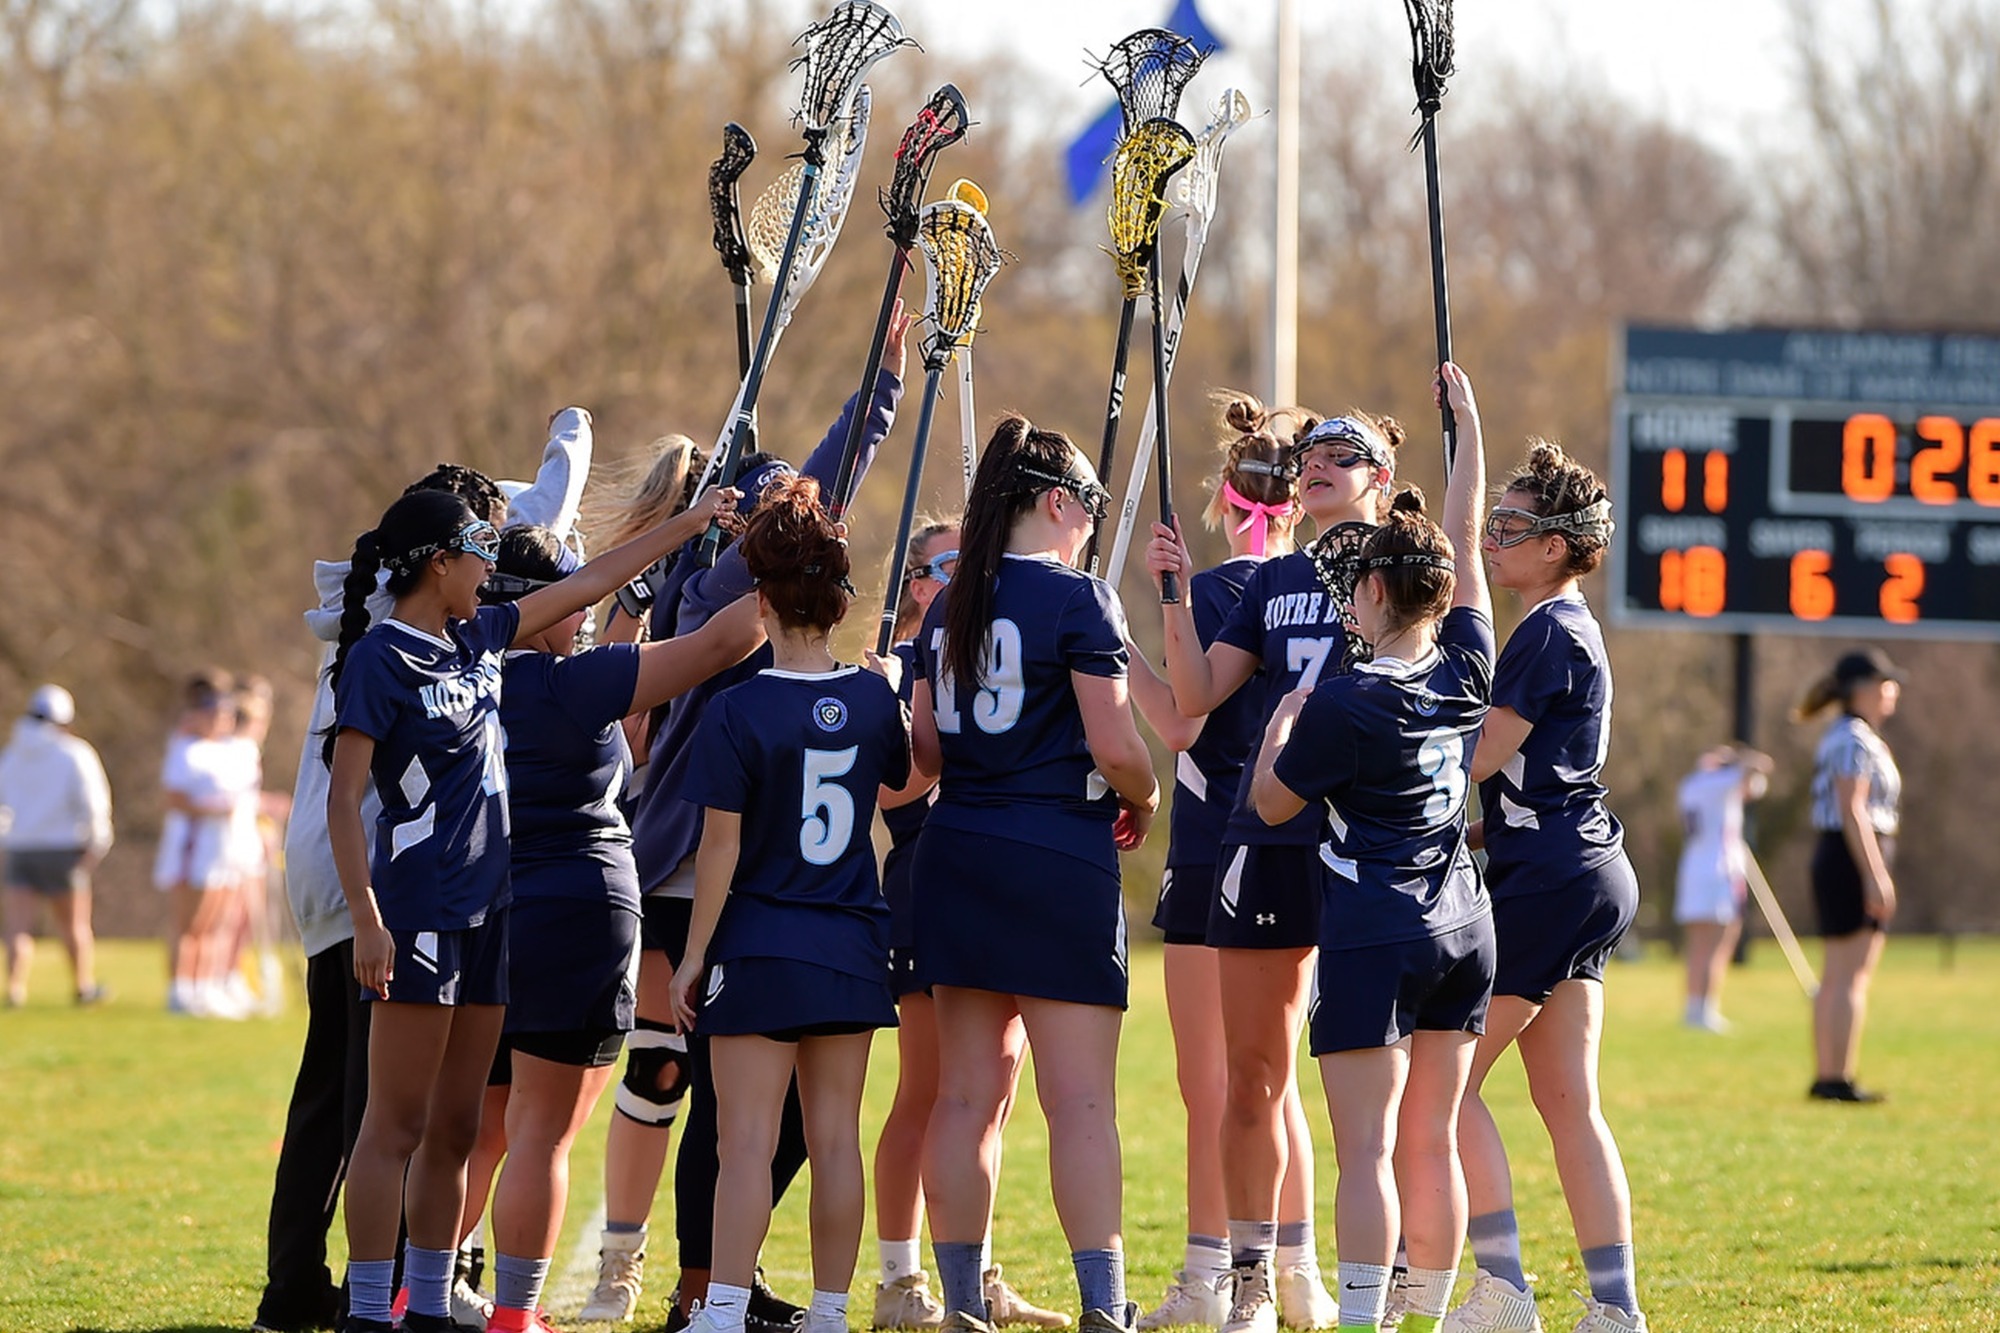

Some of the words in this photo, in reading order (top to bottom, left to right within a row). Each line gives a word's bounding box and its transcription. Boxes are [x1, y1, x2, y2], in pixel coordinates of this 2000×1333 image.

[1662, 448, 1728, 513] 11
[409, 542, 439, 560] STX
[1369, 555, 1394, 568] STX
[1402, 553, 1433, 565] STX
[1264, 592, 1323, 631] NOTRE
[1789, 549, 1836, 621] 6
[1879, 552, 1926, 625] 2
[931, 618, 1026, 735] 19
[1287, 637, 1335, 692] 7
[800, 745, 860, 867] 5
[1417, 726, 1468, 826] 3
